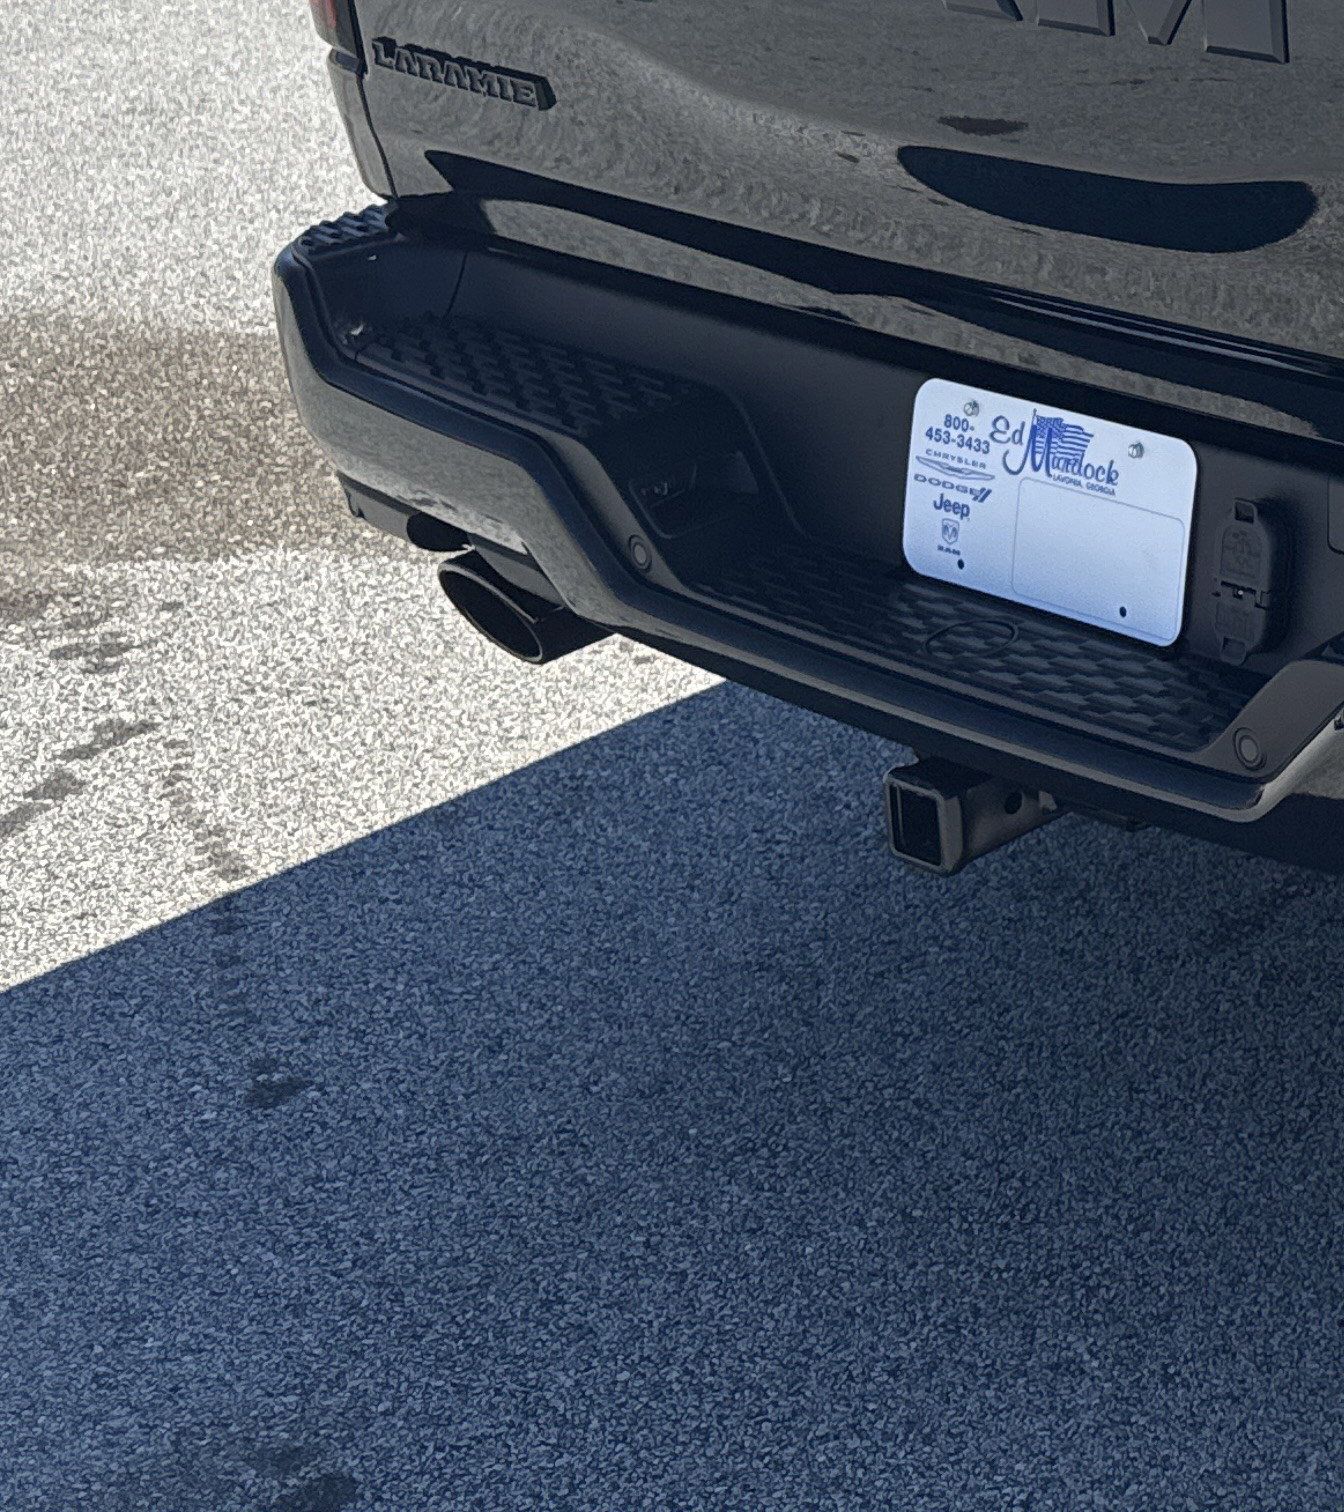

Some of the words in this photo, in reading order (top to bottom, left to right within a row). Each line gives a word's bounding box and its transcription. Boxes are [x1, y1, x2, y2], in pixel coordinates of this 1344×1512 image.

[371, 37, 545, 110] LARAMIE
[944, 413, 975, 433] 800-
[988, 414, 1026, 446] Ed
[925, 426, 990, 455] 453-3433
[925, 448, 987, 470] CHRYSLER
[914, 473, 980, 499] DODGE
[933, 492, 970, 520] Jeep
